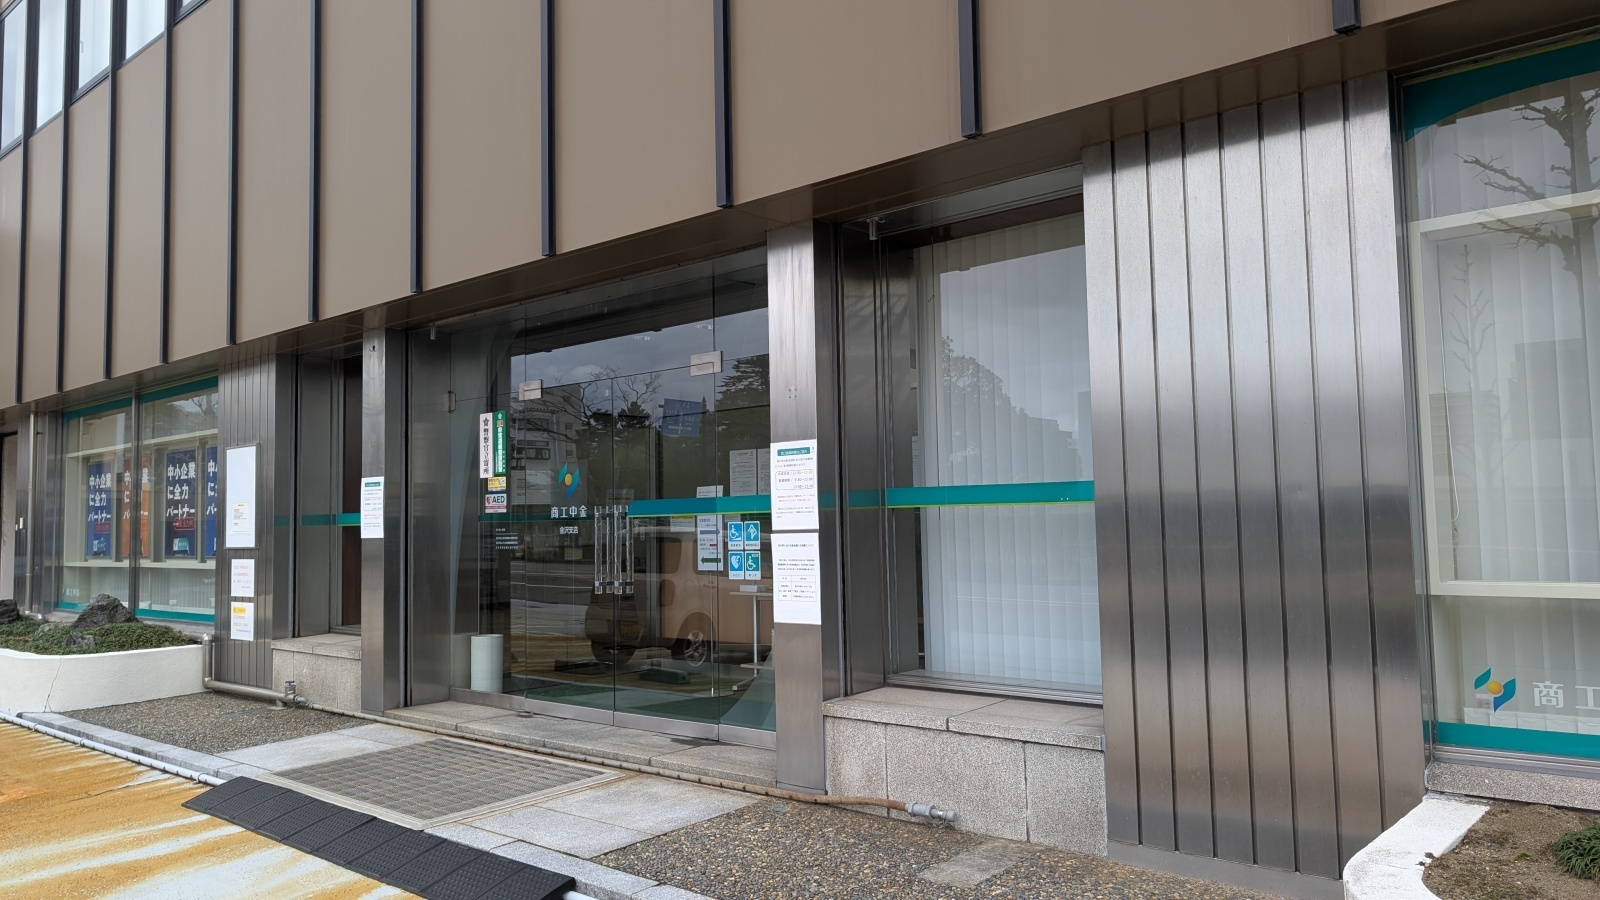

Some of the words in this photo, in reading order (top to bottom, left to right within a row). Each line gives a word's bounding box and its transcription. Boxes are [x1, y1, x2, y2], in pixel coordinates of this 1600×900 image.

[167, 462, 196, 481] 中小企業
[89, 472, 112, 490] 中小企業
[89, 491, 107, 507] に全力
[167, 483, 189, 500] に全力
[492, 495, 505, 504] AED
[88, 509, 112, 525] パートナー
[166, 503, 196, 521] パートナー
[550, 505, 587, 519] 商工中金
[1532, 681, 1600, 711] 商工
